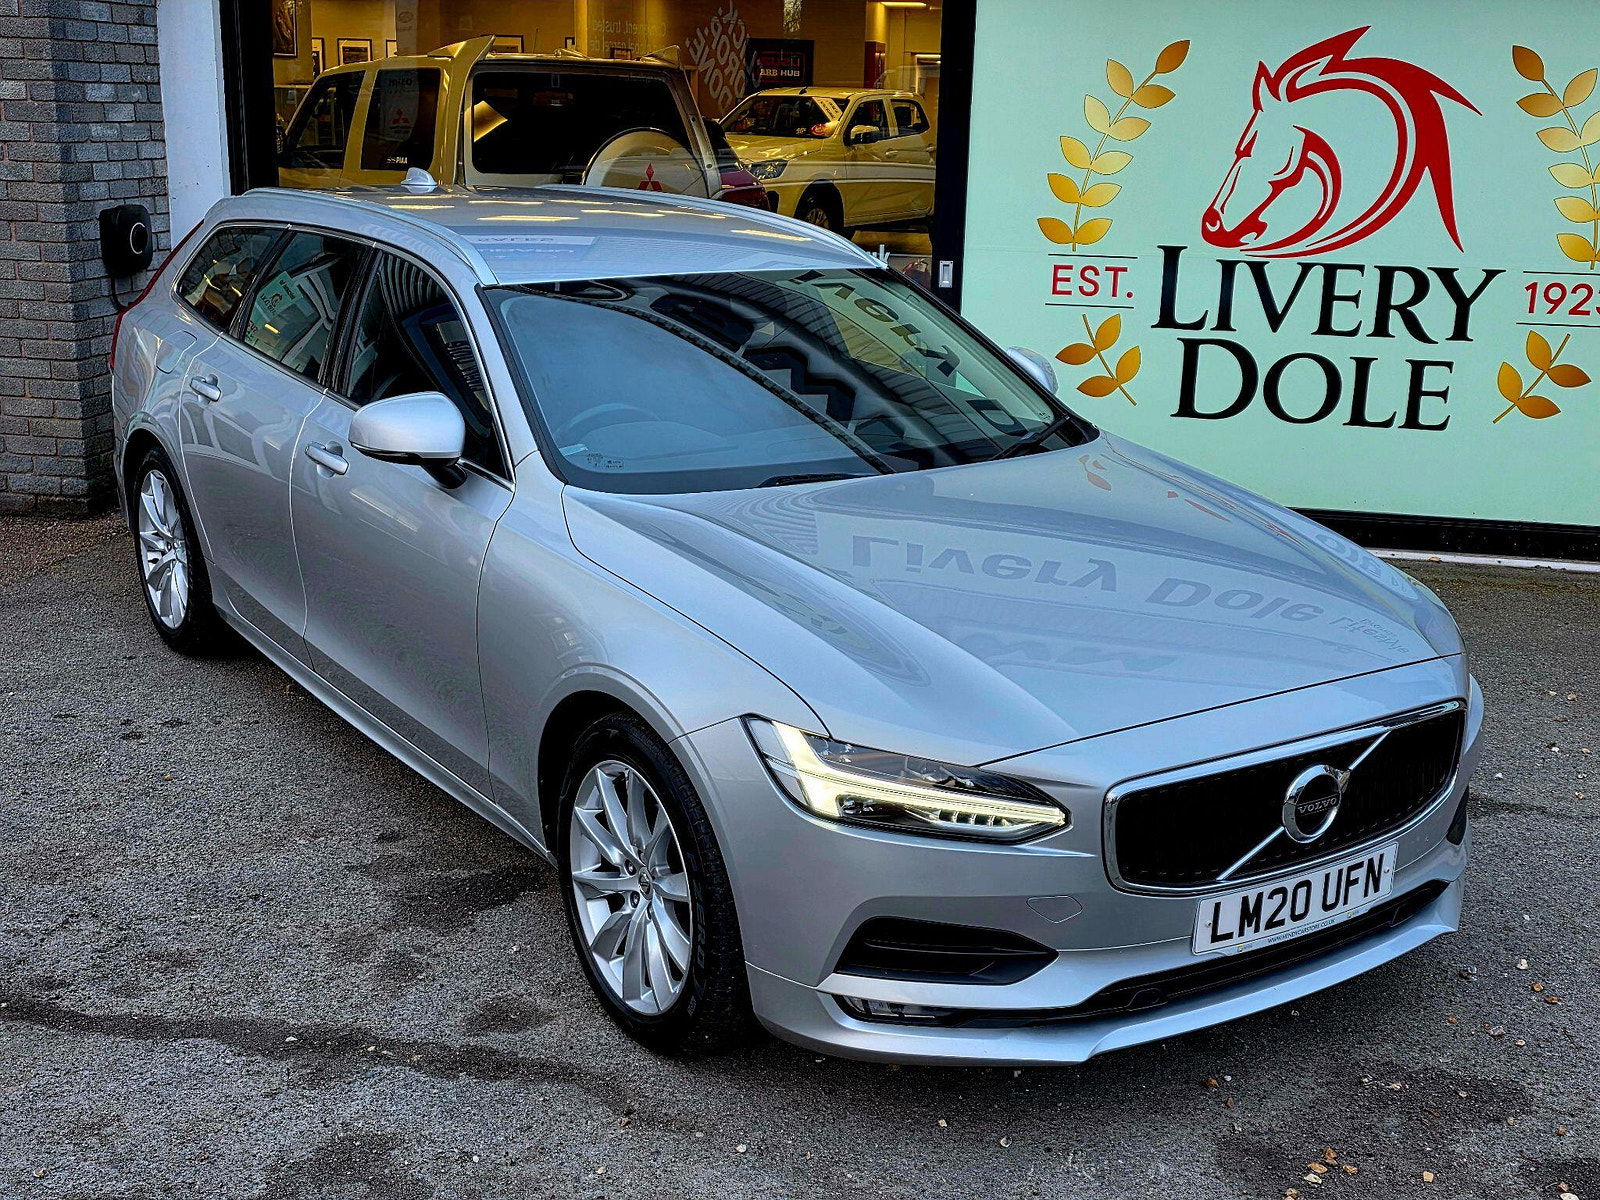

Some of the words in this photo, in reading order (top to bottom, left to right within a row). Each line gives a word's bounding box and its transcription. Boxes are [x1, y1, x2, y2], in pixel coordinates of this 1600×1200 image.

[780, 69, 800, 77] HUB
[1051, 264, 1134, 299] EST.
[1151, 245, 1506, 344] LIVERY
[1524, 281, 1600, 315] 192
[1170, 337, 1454, 431] DOLE
[1297, 796, 1338, 814] VOLVO
[1210, 879, 1313, 944] LM20
[1321, 853, 1384, 913] UFN
